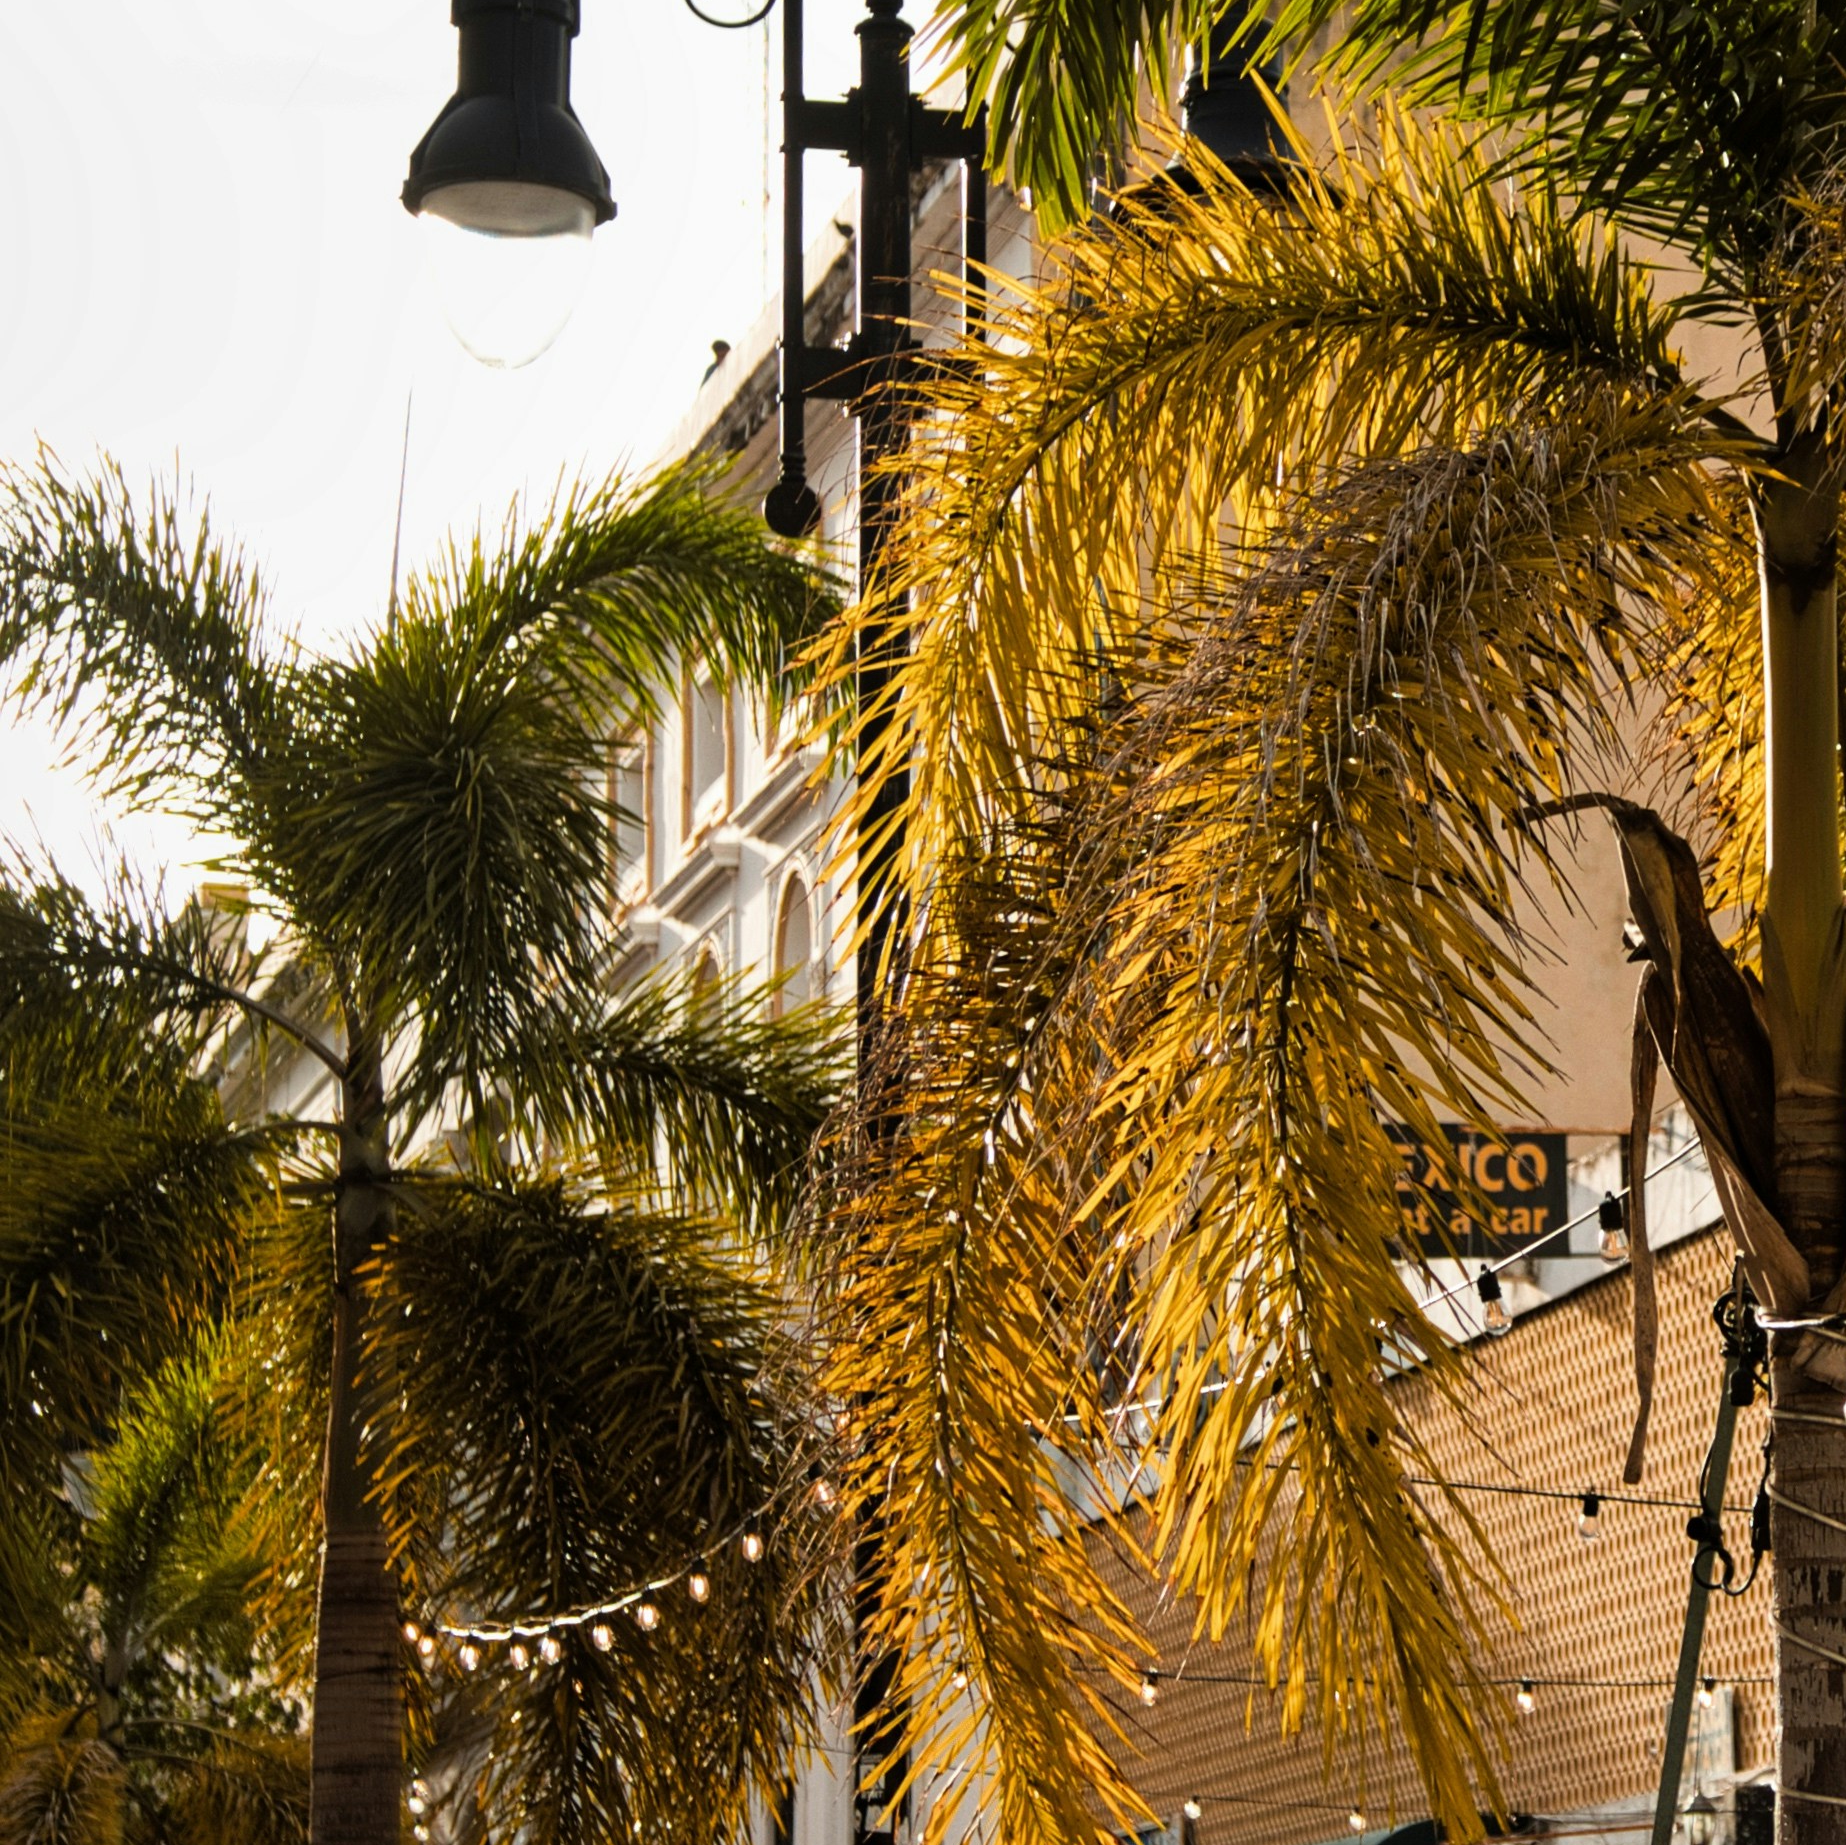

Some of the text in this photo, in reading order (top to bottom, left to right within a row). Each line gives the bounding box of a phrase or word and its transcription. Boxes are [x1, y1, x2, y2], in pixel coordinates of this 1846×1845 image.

[1395, 1143, 1548, 1192] EXICO
[1451, 1207, 1471, 1234] a
[1491, 1206, 1548, 1234] car
